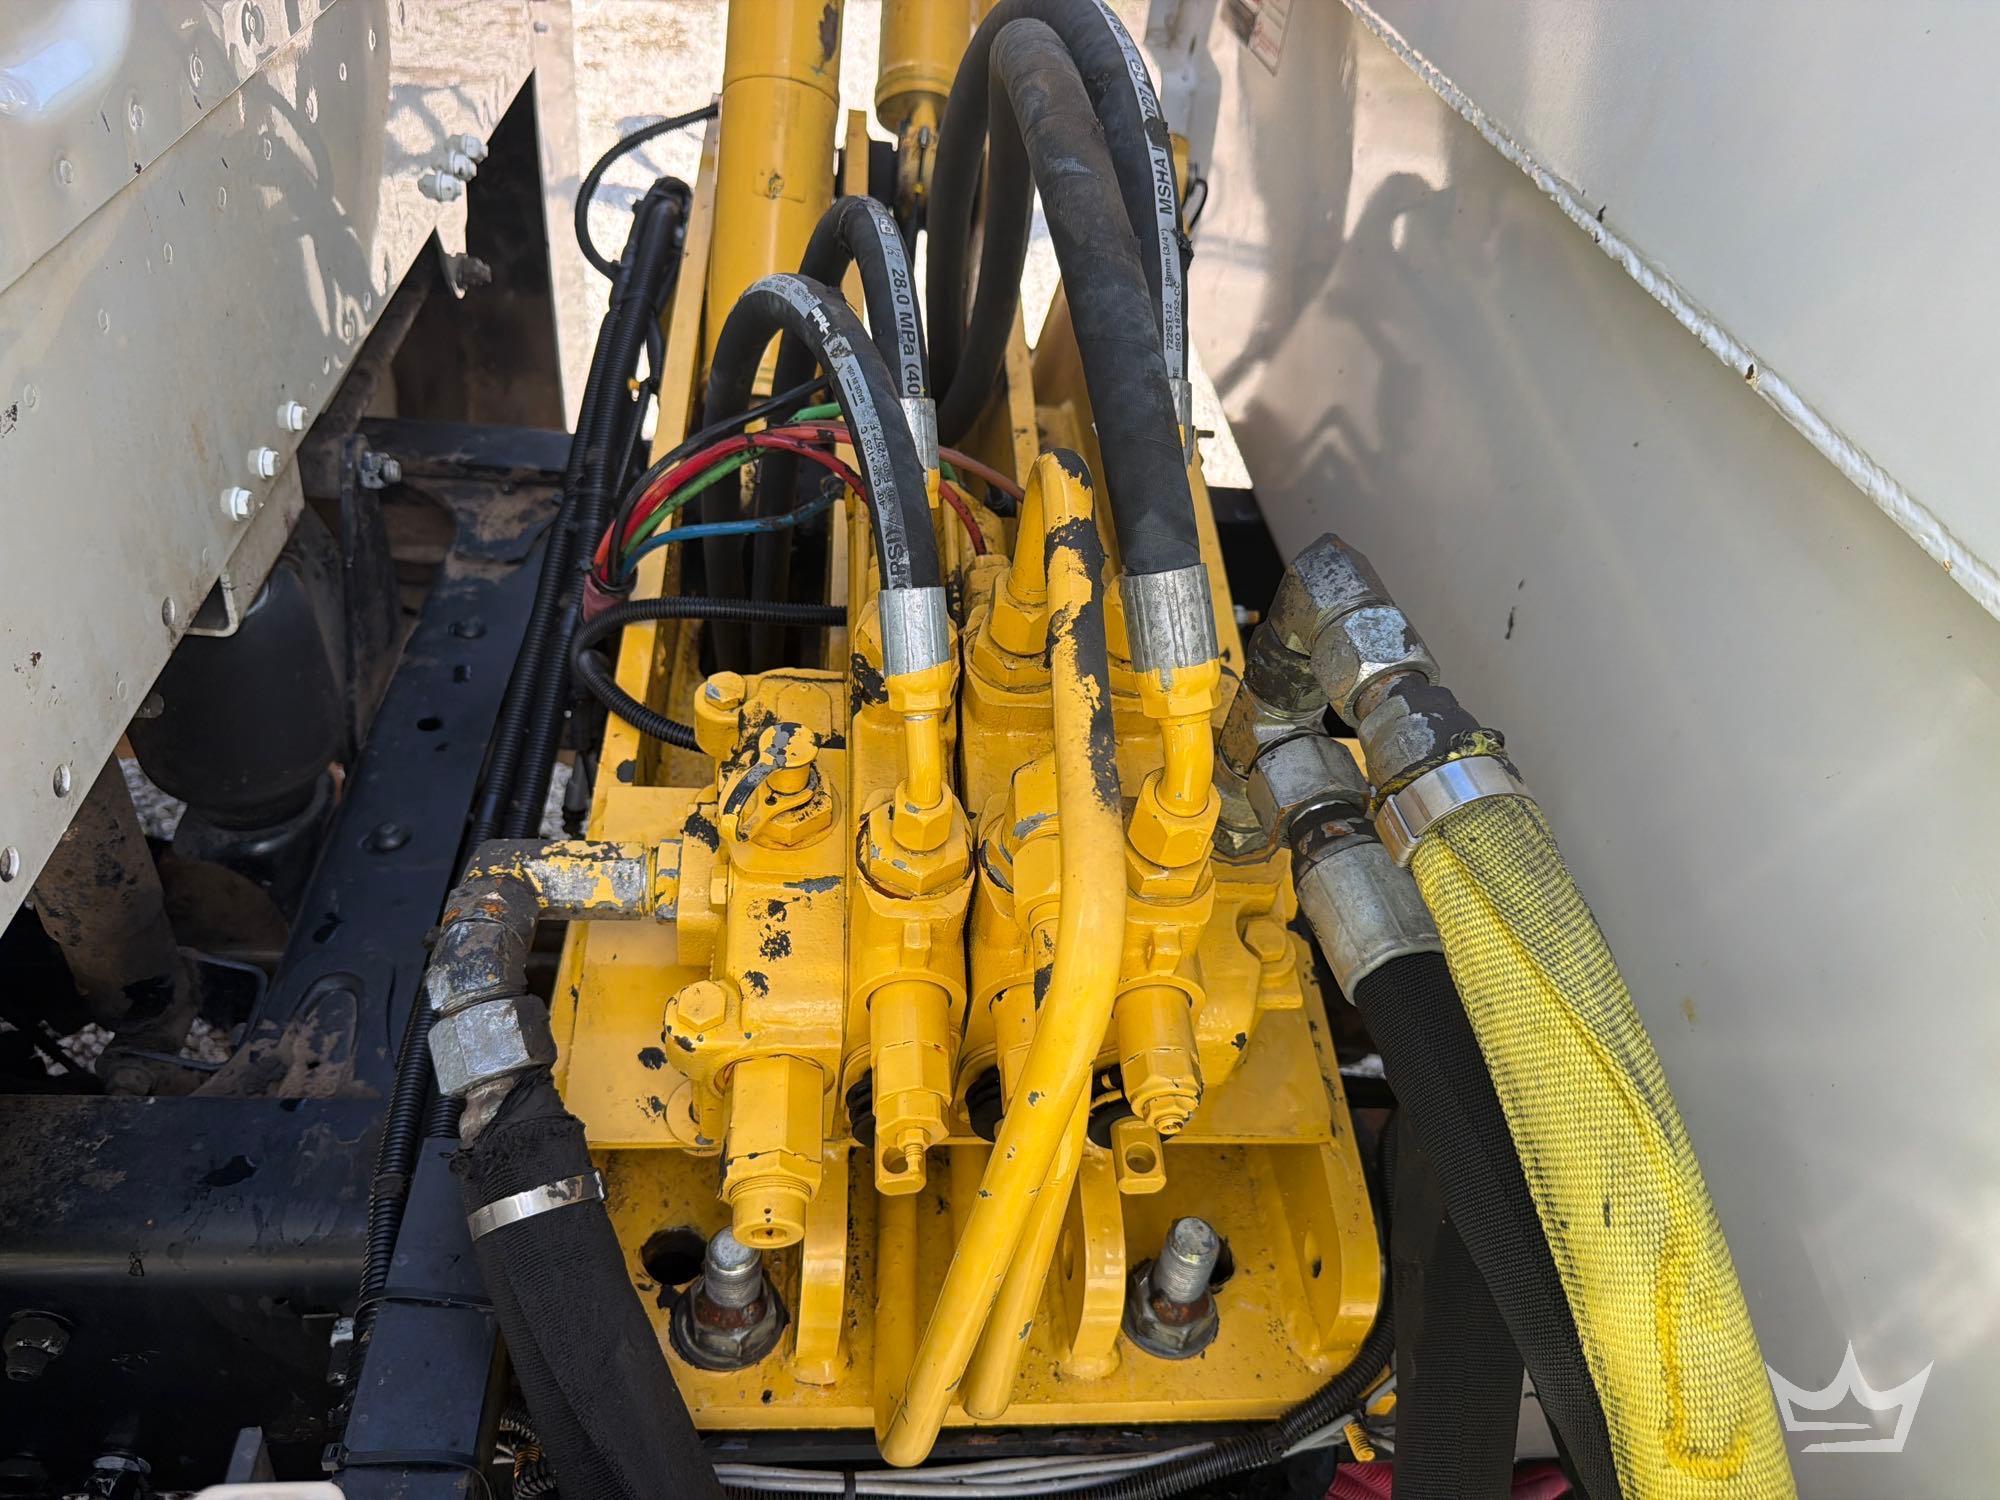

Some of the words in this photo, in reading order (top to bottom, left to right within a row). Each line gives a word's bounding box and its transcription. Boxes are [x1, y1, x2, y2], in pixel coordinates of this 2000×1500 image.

[1154, 158, 1174, 215] MSHA
[891, 268, 910, 306] 28,0
[1165, 258, 1174, 288] 19mm
[1174, 281, 1182, 328] 18752-CC
[899, 312, 916, 356] MPa
[1165, 303, 1174, 351] 722ST-12
[846, 364, 856, 377] USA
[854, 384, 865, 404] MADE
[860, 426, 868, 435] C
